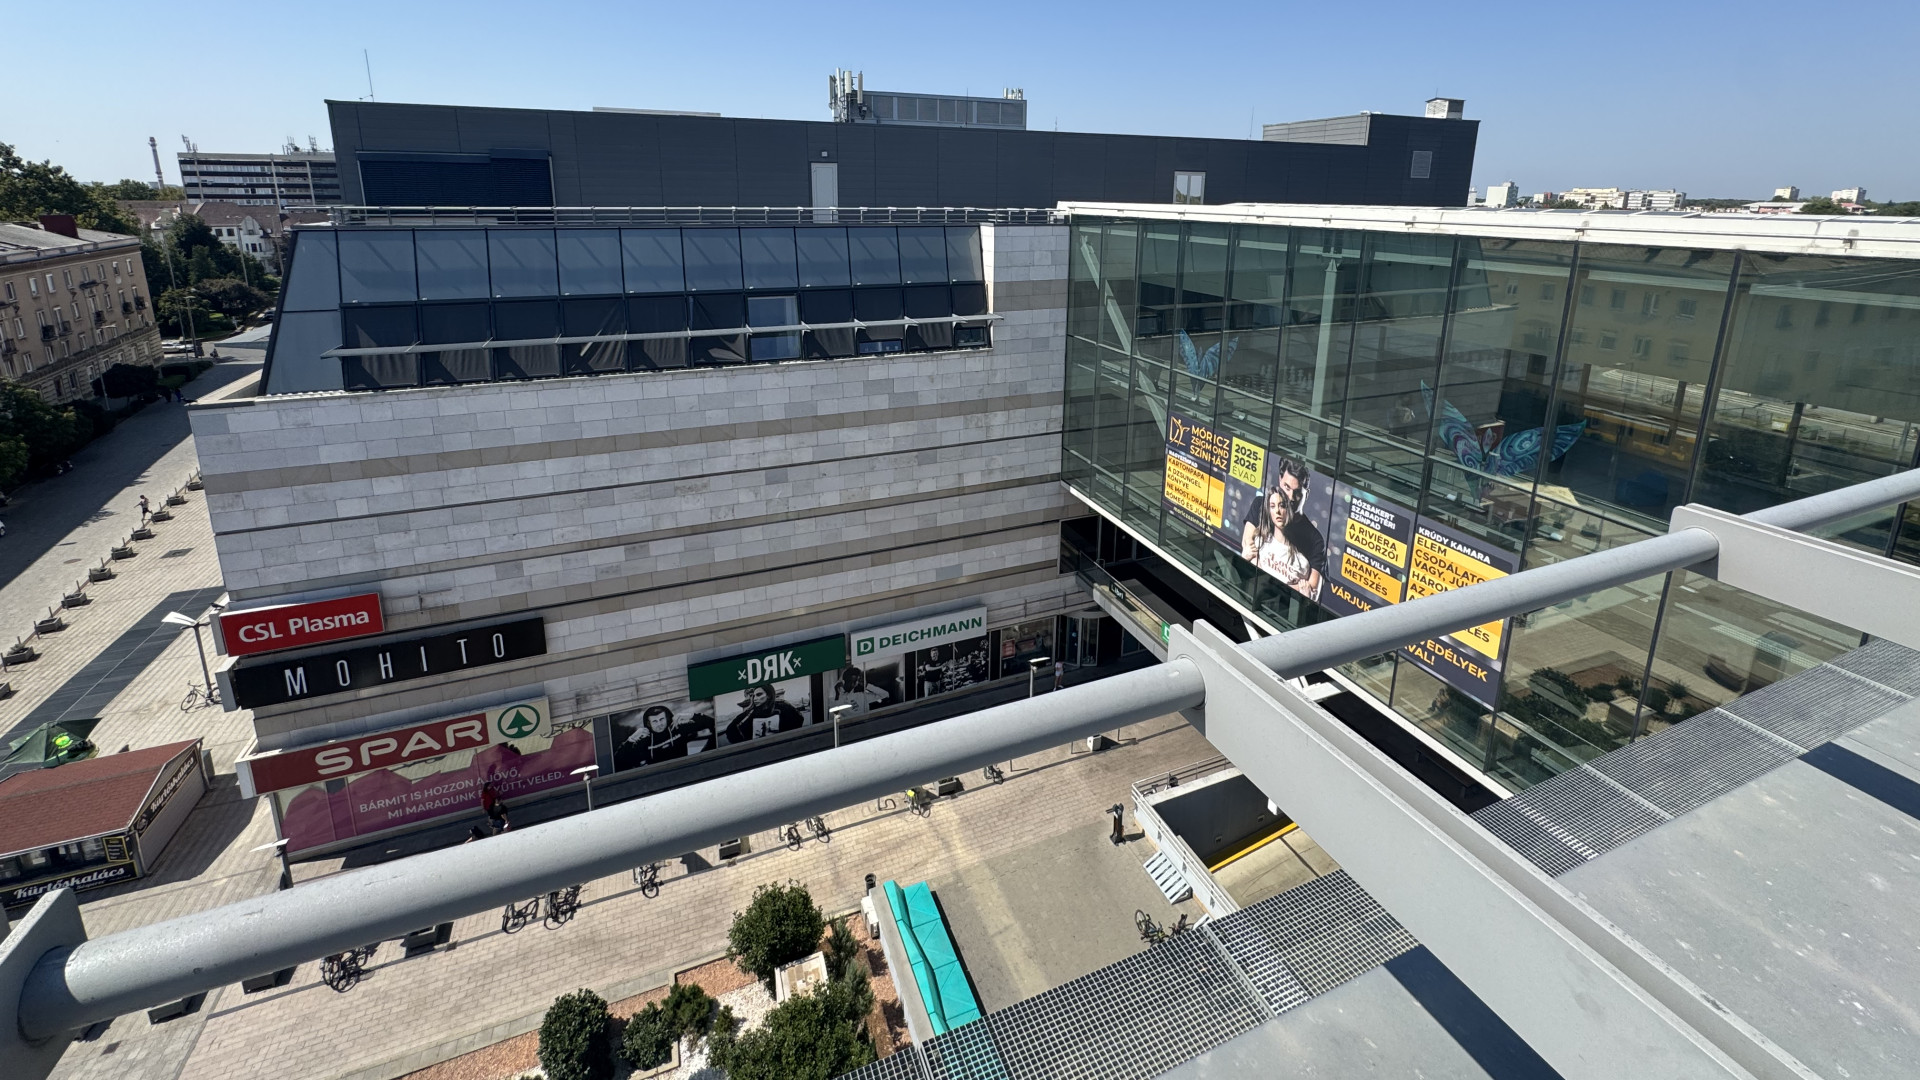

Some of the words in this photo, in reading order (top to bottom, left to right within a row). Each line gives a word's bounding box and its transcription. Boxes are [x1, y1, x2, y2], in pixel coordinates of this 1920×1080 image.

[1191, 425, 1230, 450] MÓRICZ
[1191, 436, 1229, 459] ZSIGMOND
[1189, 445, 1228, 470] SZÍNHÁZ
[1233, 455, 1257, 472] 2026
[1234, 443, 1262, 461] 2025-
[1168, 458, 1205, 480] KARTONPAPA
[1172, 468, 1201, 489] DZSUNGEL
[1232, 465, 1257, 483] ÉVAD
[1167, 482, 1174, 491] NE
[1350, 512, 1381, 530] SZÍNPAD
[1351, 505, 1396, 530] SZABADTÉRI
[1352, 498, 1395, 520] RÓZSAKERT
[1349, 523, 1356, 531] A
[1349, 532, 1398, 562] VADORZÓI
[1416, 537, 1447, 556] ELEM
[1418, 527, 1449, 545] KRÚDY
[1450, 540, 1491, 564] KAMARA
[1345, 558, 1381, 580] ARANY-
[1346, 547, 1369, 563] BENCS
[1370, 558, 1391, 575] VILLA
[1414, 558, 1446, 581] VAGY,
[1415, 549, 1486, 584] CSODÁLATO
[1344, 567, 1388, 596] METSZÉS
[1410, 583, 1426, 596] AZ
[1412, 571, 1449, 592] HÁRO
[1330, 583, 1372, 611] VÁRJUK
[238, 622, 283, 643] CSL
[288, 611, 369, 635] Plasma
[879, 617, 982, 649] DEICHMANN
[284, 633, 505, 697] MOHITO
[314, 719, 483, 775] SPAR
[360, 794, 407, 813] BÁRMIT
[410, 791, 422, 800] IS
[424, 779, 474, 797] HOZZON
[476, 777, 485, 785] A
[489, 767, 521, 782] JÖVŐ,
[387, 809, 403, 819] MI
[405, 791, 476, 814] MARADUNK
[527, 771, 565, 786] VELED.
[13, 867, 125, 899] Kürtőskalács
